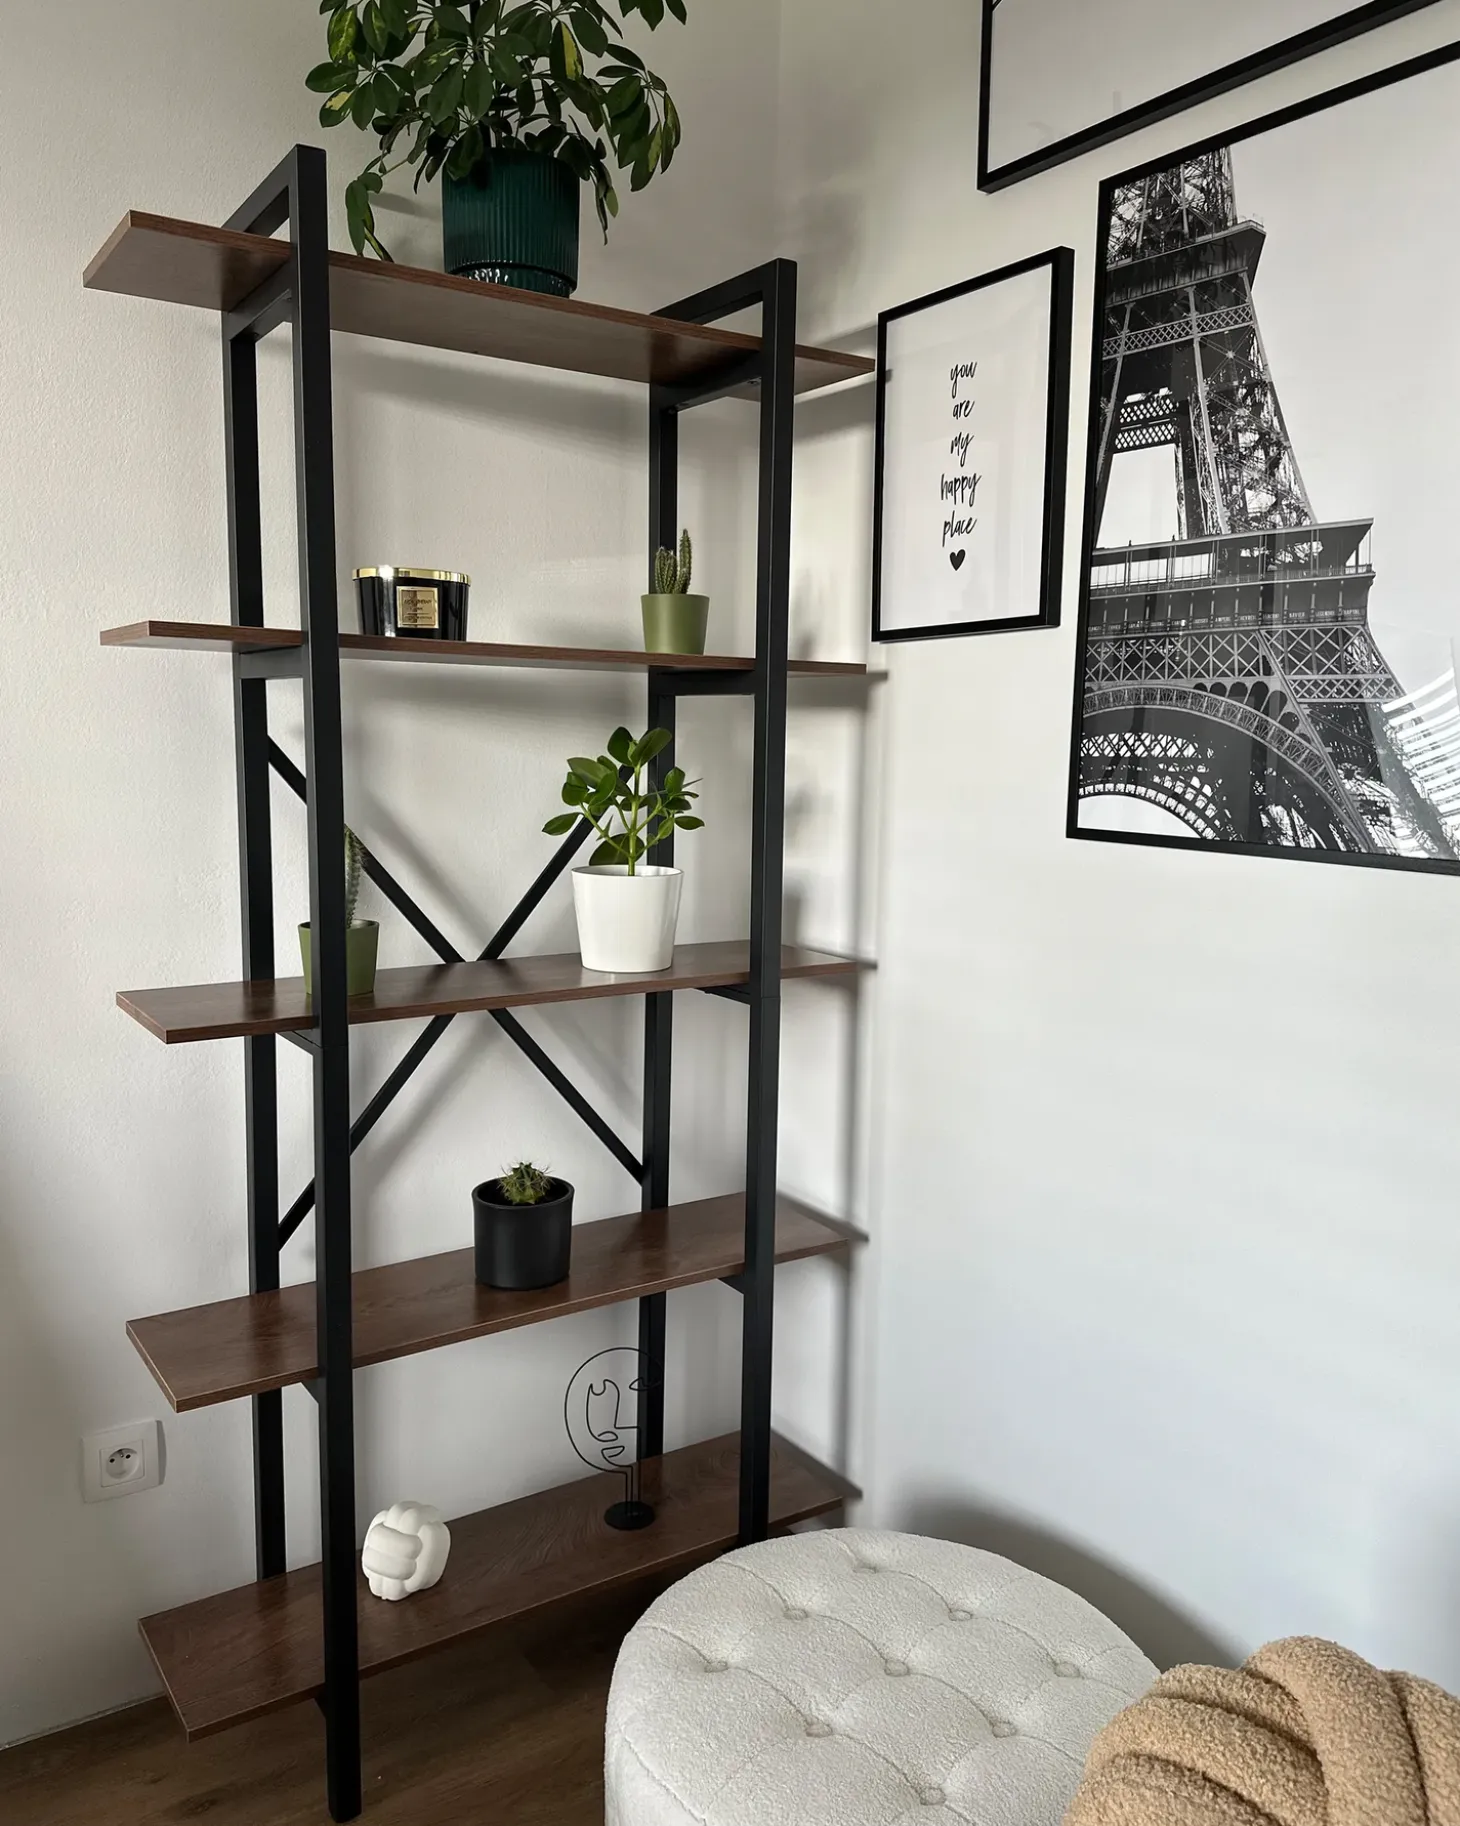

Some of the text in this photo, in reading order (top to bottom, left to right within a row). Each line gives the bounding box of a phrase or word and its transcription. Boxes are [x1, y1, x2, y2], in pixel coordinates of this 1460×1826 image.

[950, 361, 978, 399] you
[953, 399, 976, 420] are
[950, 431, 975, 468] my
[940, 473, 983, 508] happy
[942, 510, 978, 548] place
